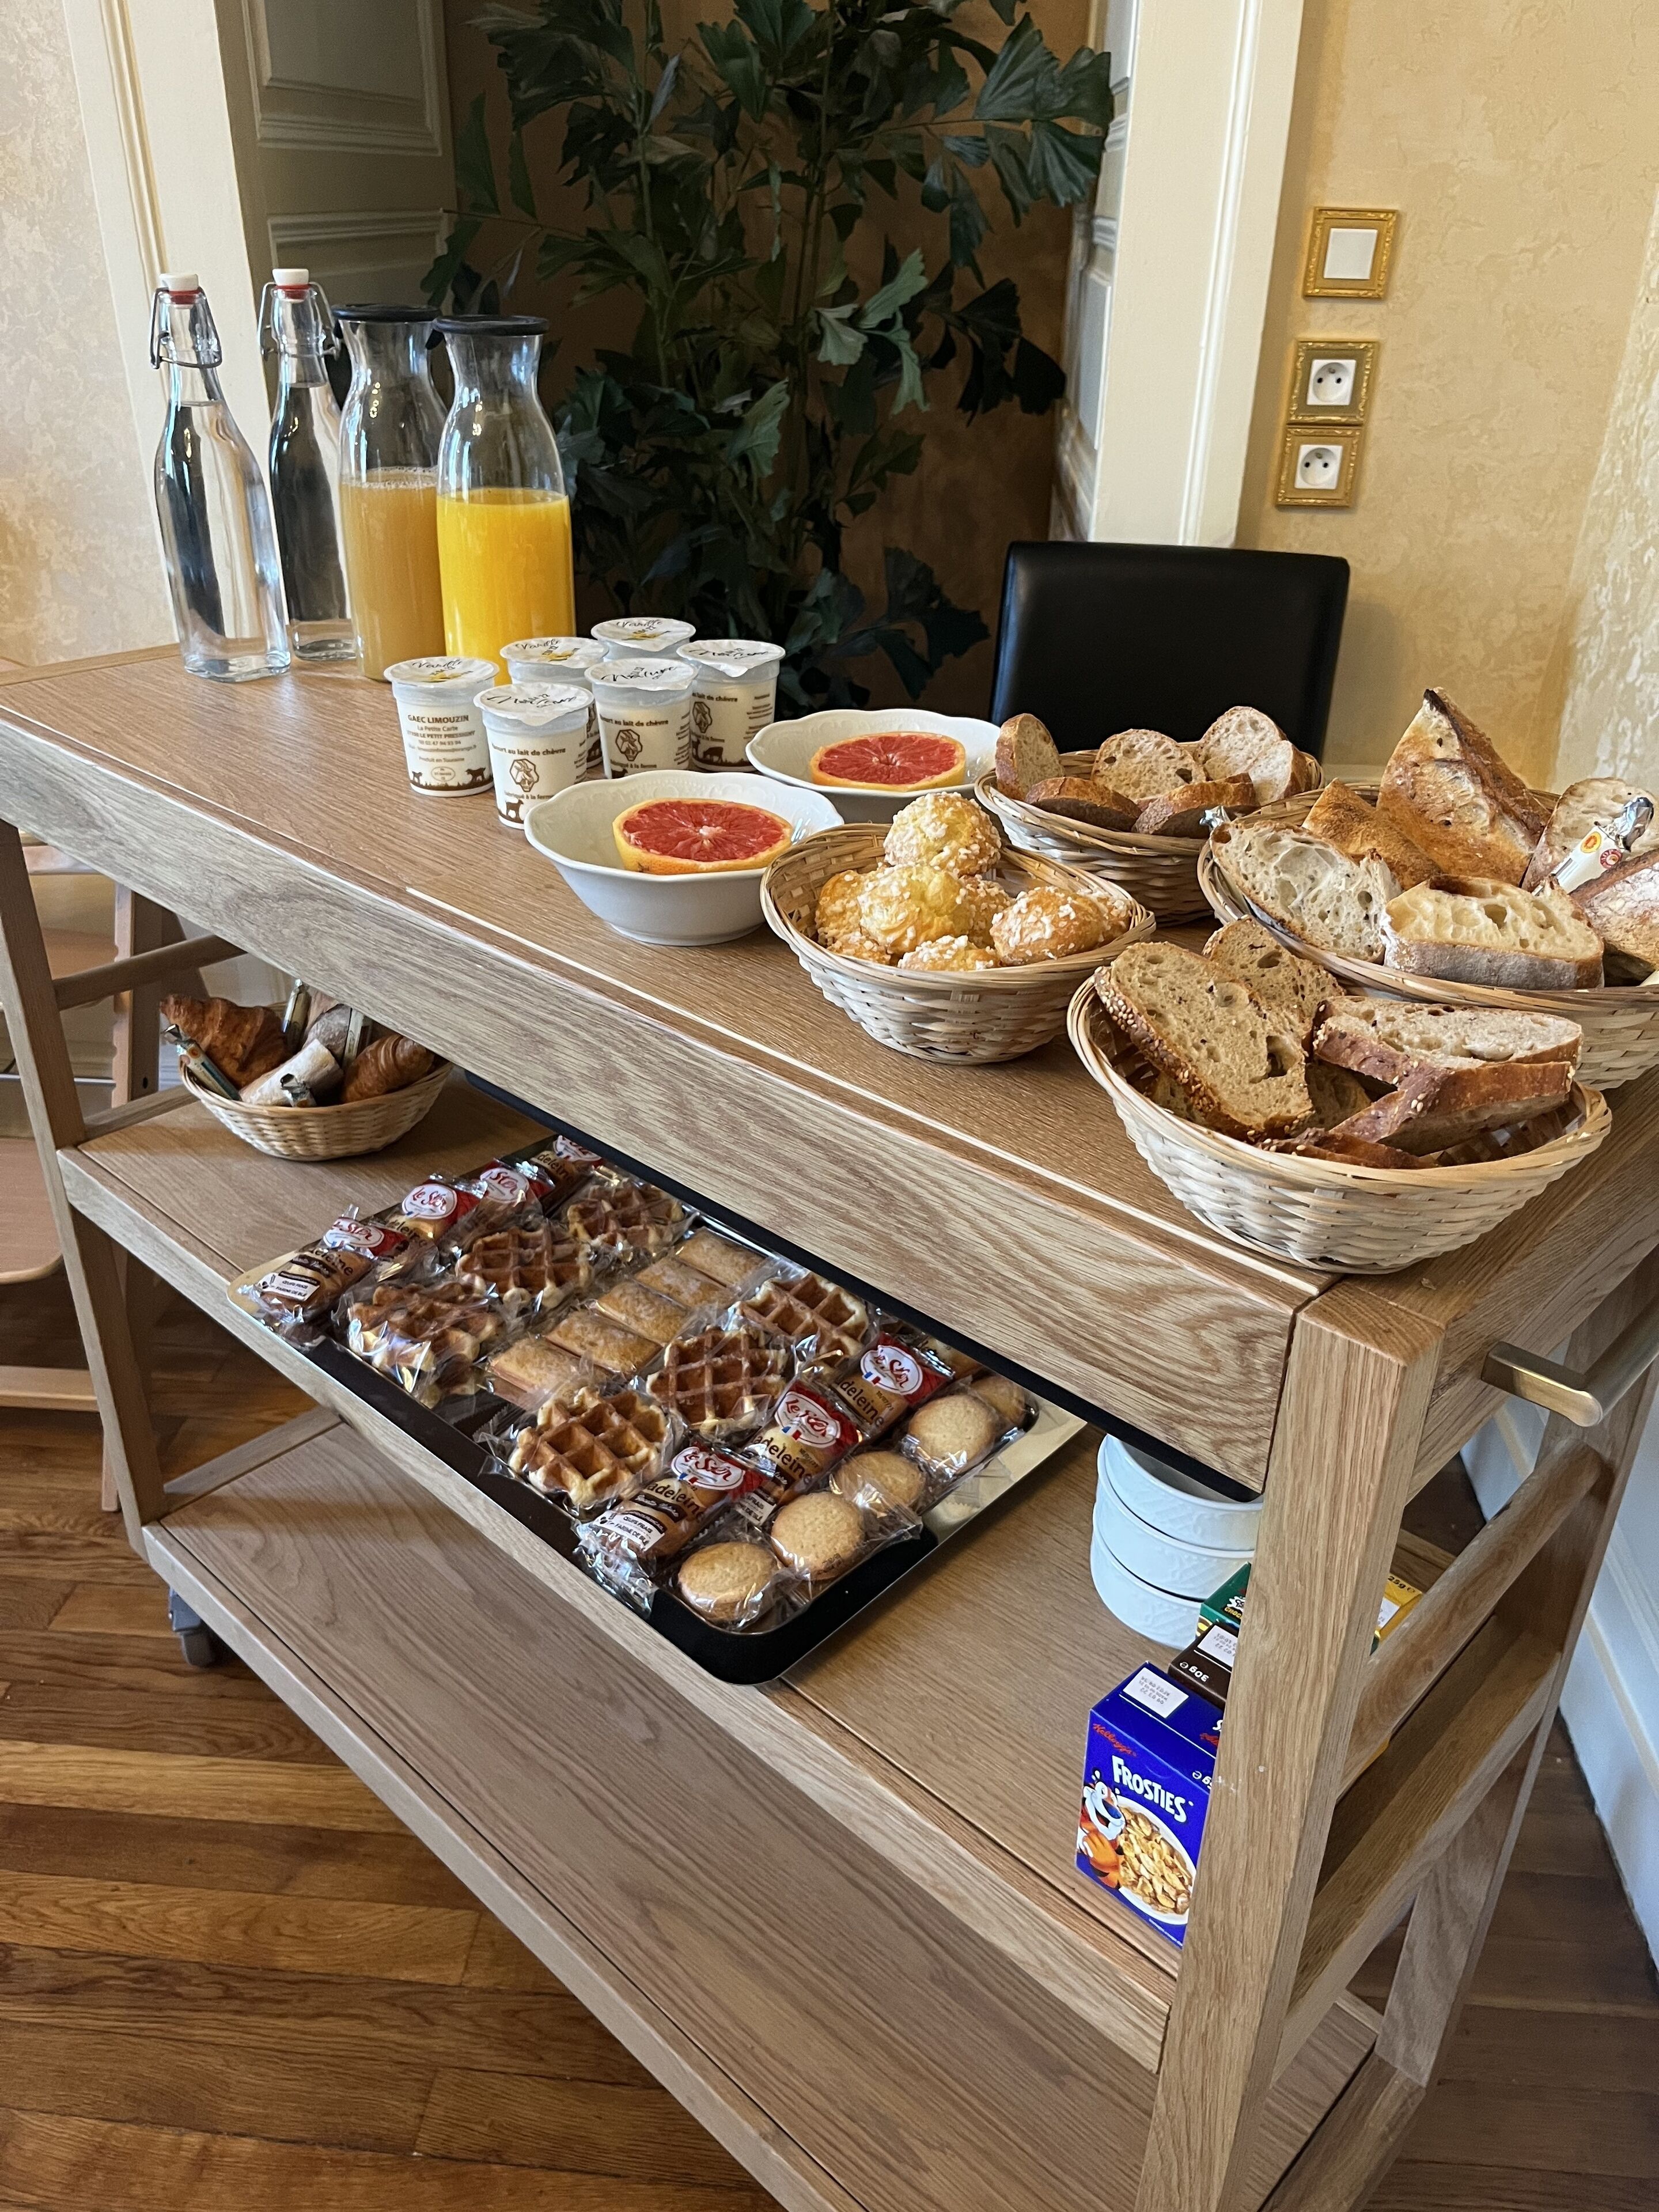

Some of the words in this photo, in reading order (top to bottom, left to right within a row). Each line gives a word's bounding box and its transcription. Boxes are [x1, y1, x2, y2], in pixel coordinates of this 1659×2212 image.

[408, 714, 426, 724] GAEC
[427, 715, 469, 724] LIMOUZIN
[753, 1435, 813, 1484] adeleine
[646, 1481, 705, 1522] adeleine
[1112, 1755, 1187, 1823] FROSTIES
